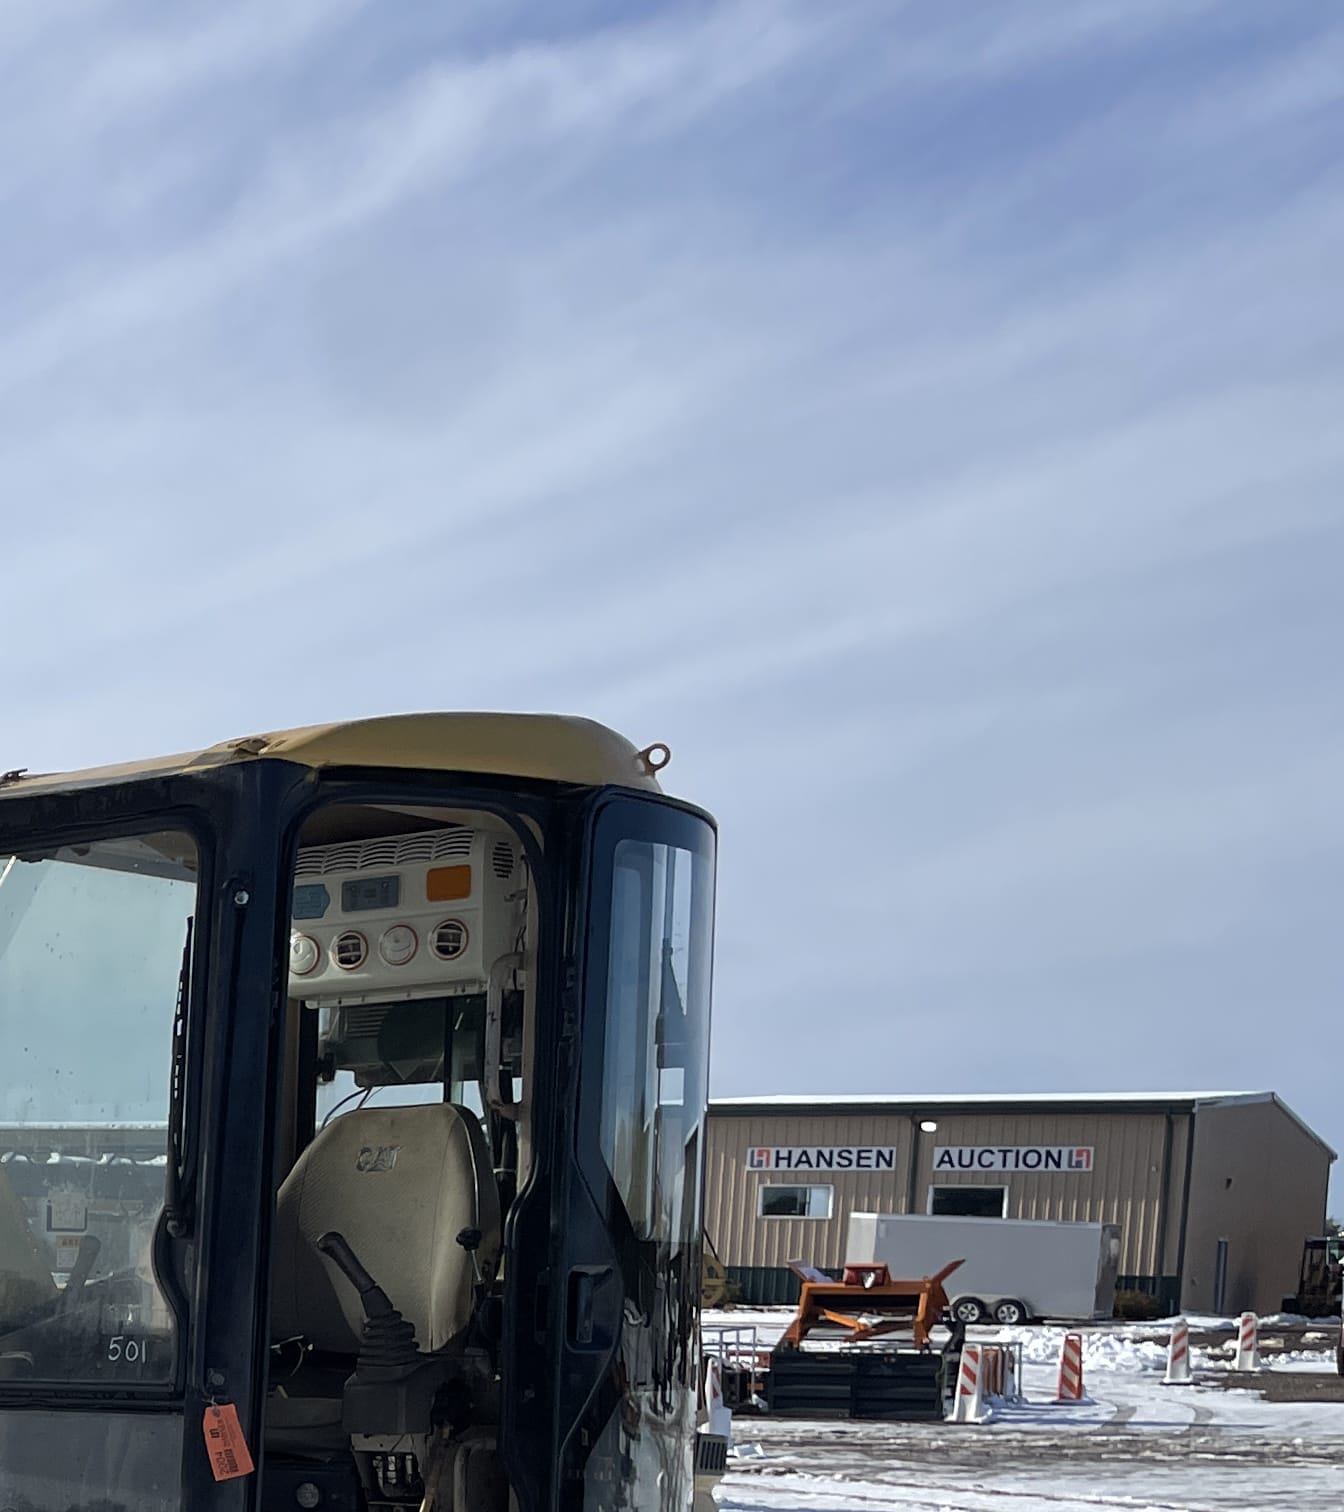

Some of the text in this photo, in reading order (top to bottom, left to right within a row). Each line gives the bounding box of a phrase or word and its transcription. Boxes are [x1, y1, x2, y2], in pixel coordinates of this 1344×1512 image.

[356, 1146, 400, 1173] CAT
[774, 1149, 1062, 1169] HANSEN AUCTION
[108, 1336, 146, 1363] 501
